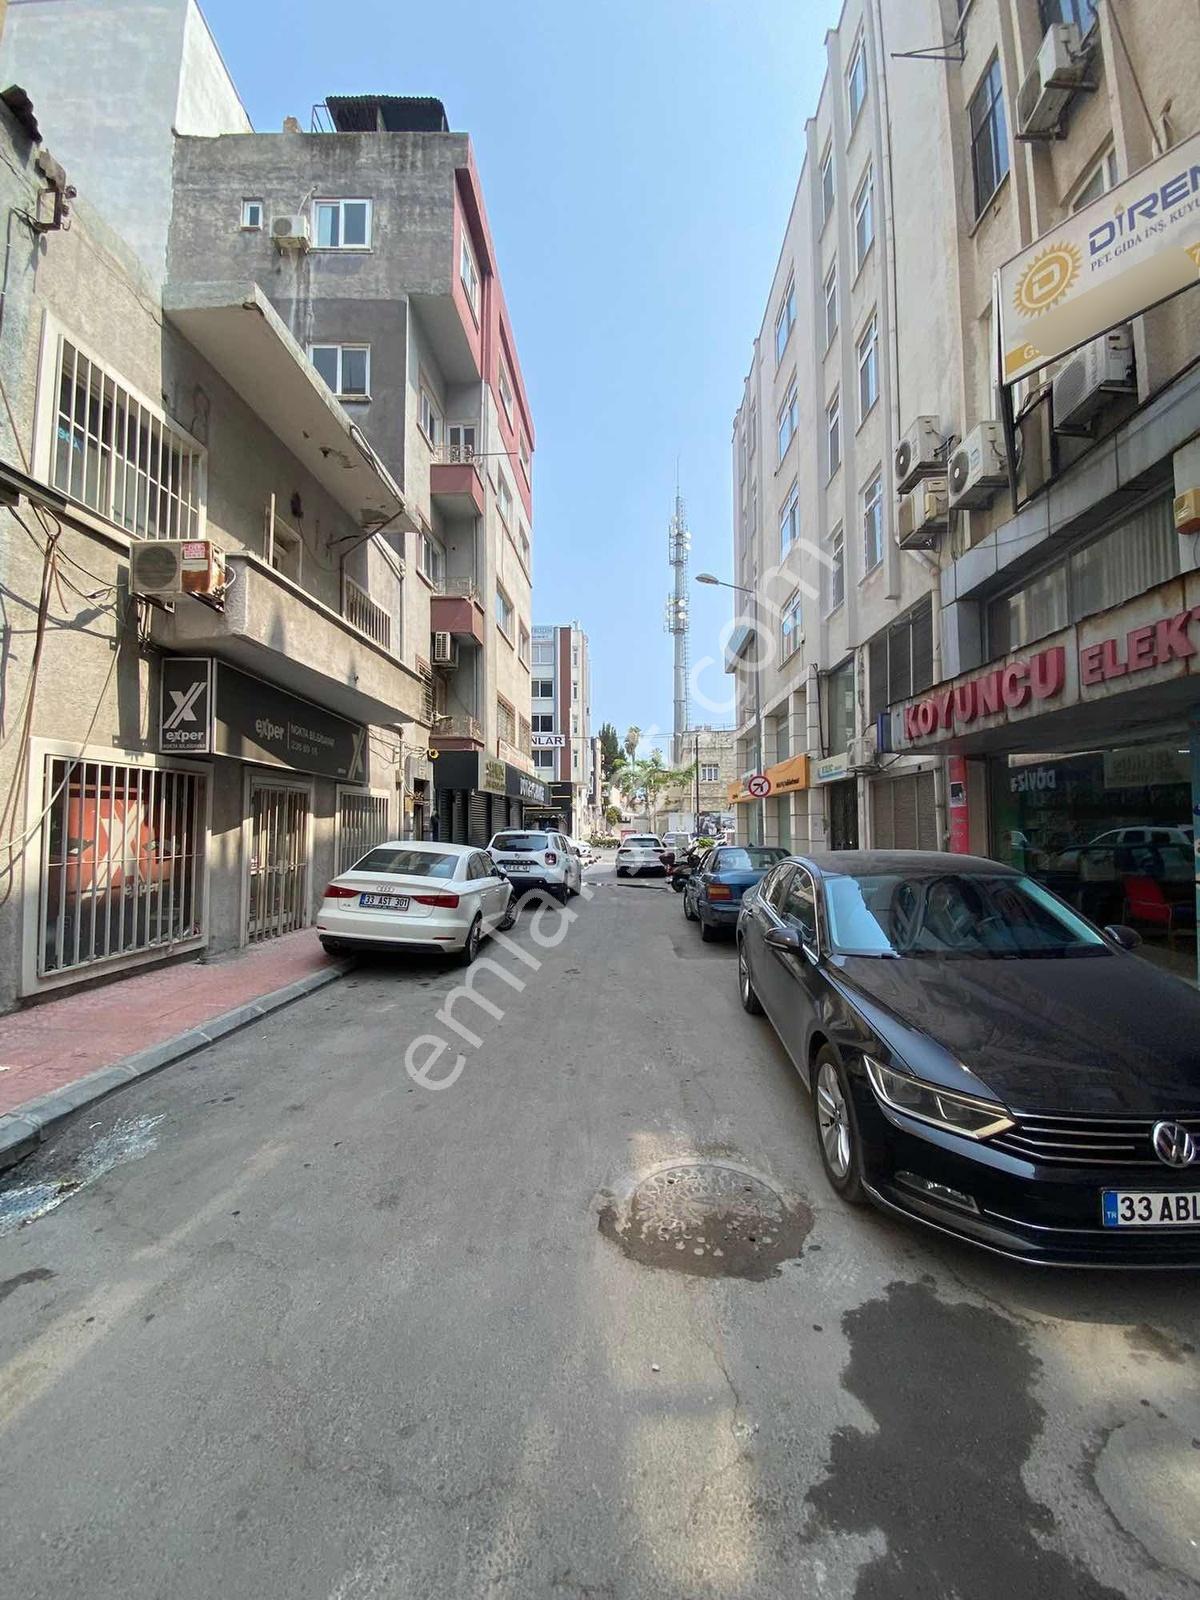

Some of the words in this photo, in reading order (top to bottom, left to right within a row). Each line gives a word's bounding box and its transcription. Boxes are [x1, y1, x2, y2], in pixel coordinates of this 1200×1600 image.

[1113, 235, 1142, 257] GIDA
[903, 645, 1066, 740] KOYUNCU
[255, 718, 285, 741] exper
[365, 895, 375, 904] 33
[378, 896, 391, 905] AST
[1120, 1196, 1153, 1222] 33
[1159, 1195, 1200, 1222] ABL
